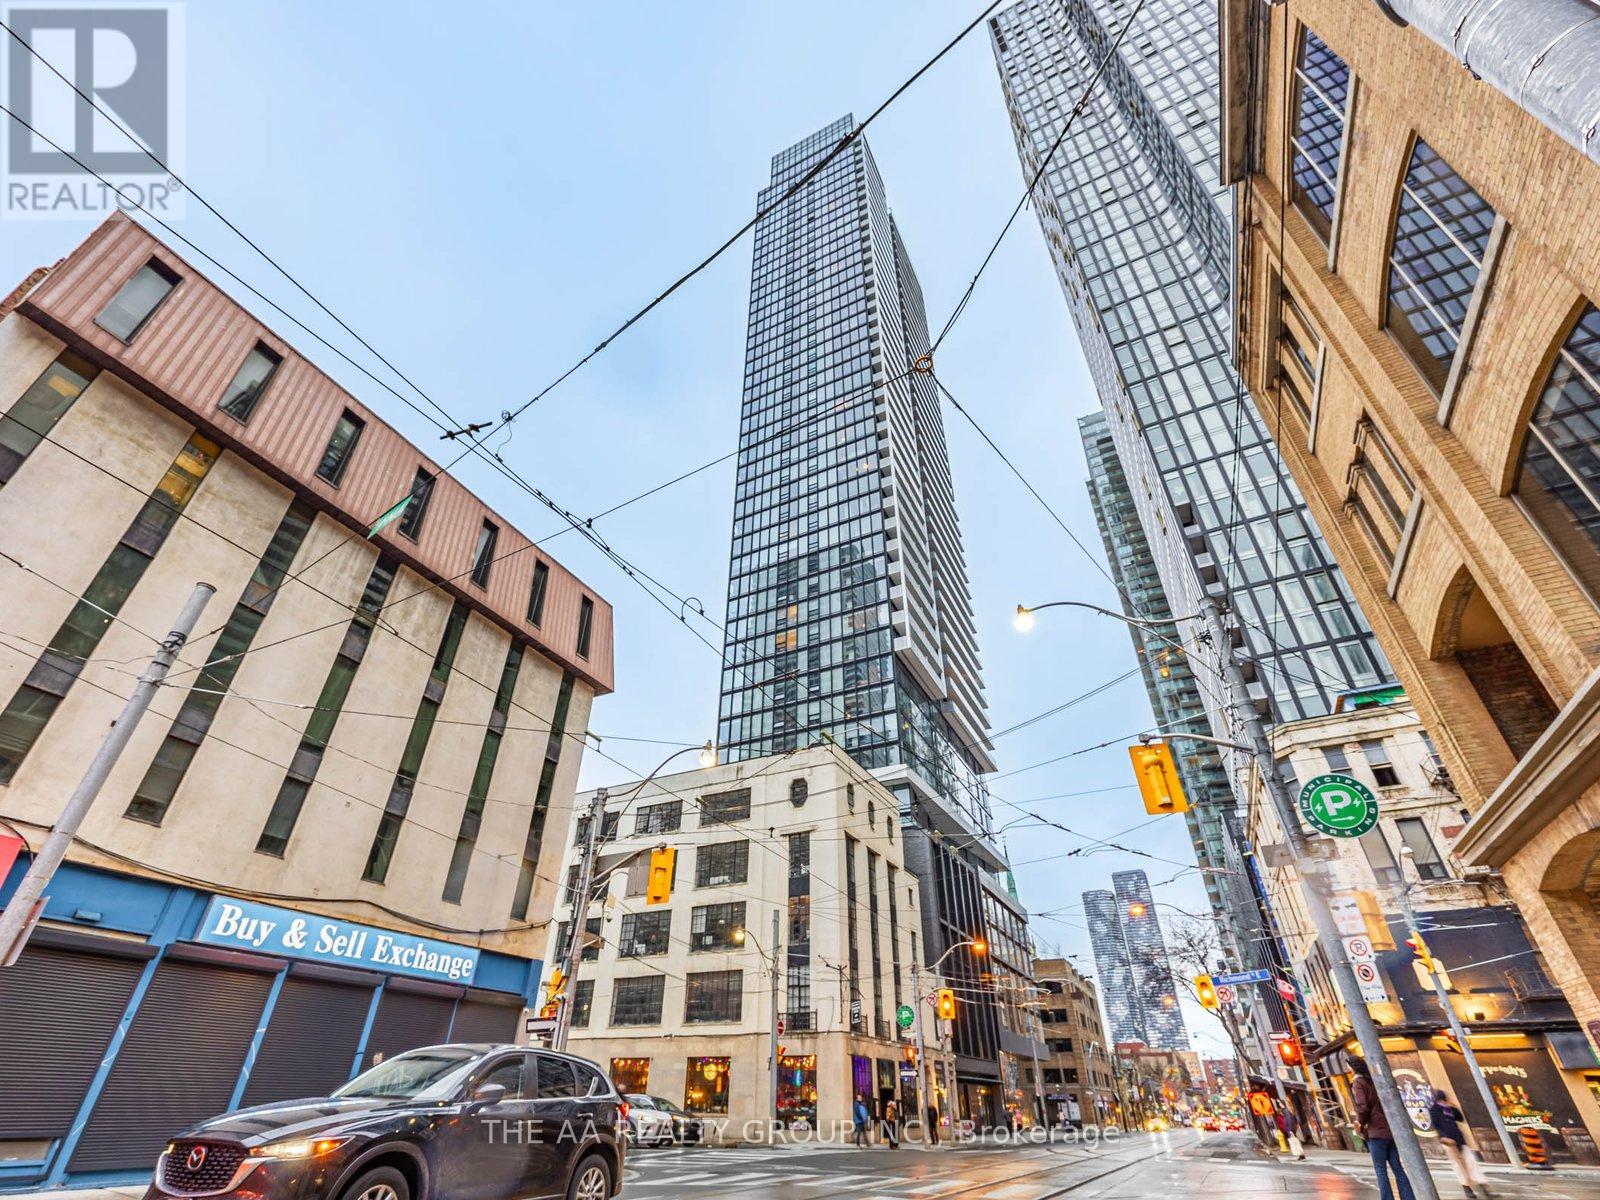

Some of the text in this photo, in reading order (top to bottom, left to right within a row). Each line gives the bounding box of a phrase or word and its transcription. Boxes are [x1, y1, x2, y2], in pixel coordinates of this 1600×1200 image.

[1302, 776, 1369, 808] MUNICIPAL
[1320, 790, 1352, 816] P
[1306, 806, 1376, 836] PARKING
[211, 904, 474, 980] Buy & Sell Exchange
